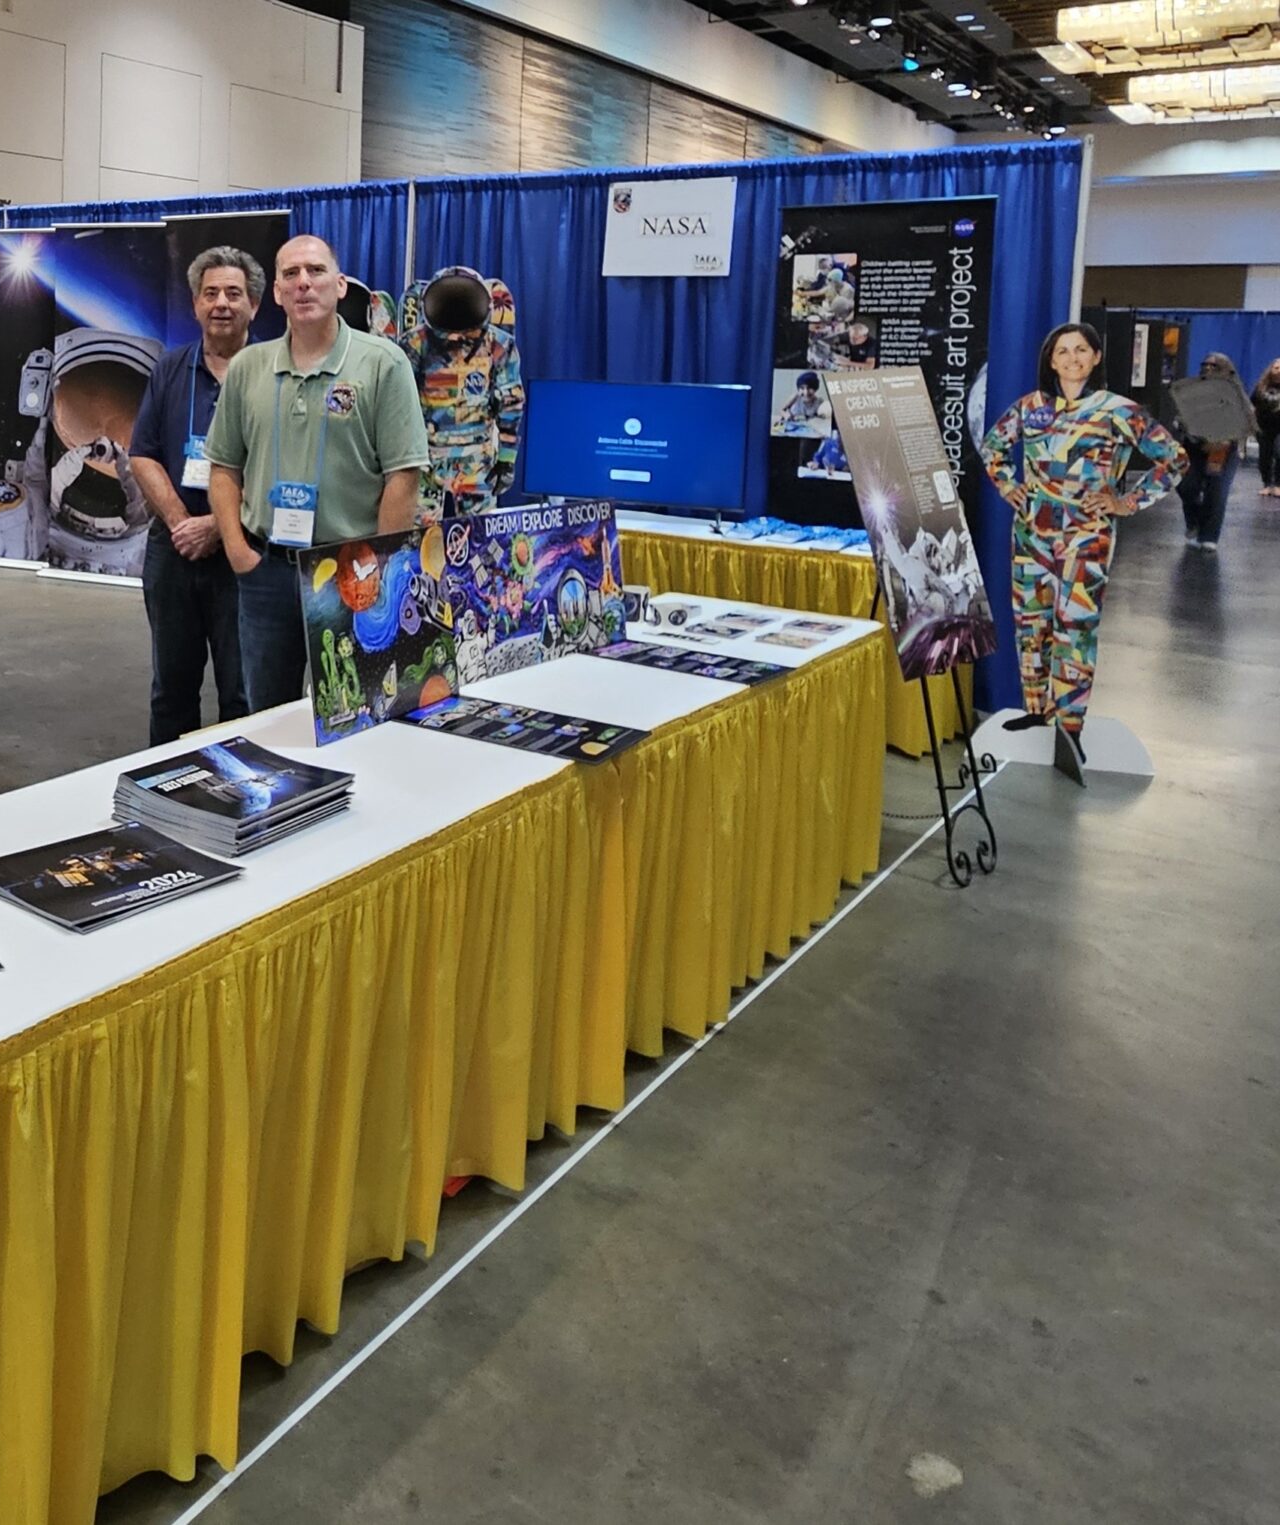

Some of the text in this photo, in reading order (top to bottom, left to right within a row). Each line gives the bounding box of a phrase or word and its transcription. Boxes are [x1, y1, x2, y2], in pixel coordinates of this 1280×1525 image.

[642, 216, 707, 236] NASA
[946, 246, 977, 329] project
[944, 336, 968, 368] art
[827, 381, 842, 395] BE
[842, 378, 878, 394] INSPIRED
[846, 394, 886, 411] CREATIVE
[851, 414, 880, 430] HEARD
[485, 502, 611, 537] DREAM EXPLORE DISCOVER
[139, 870, 198, 891] 2024
